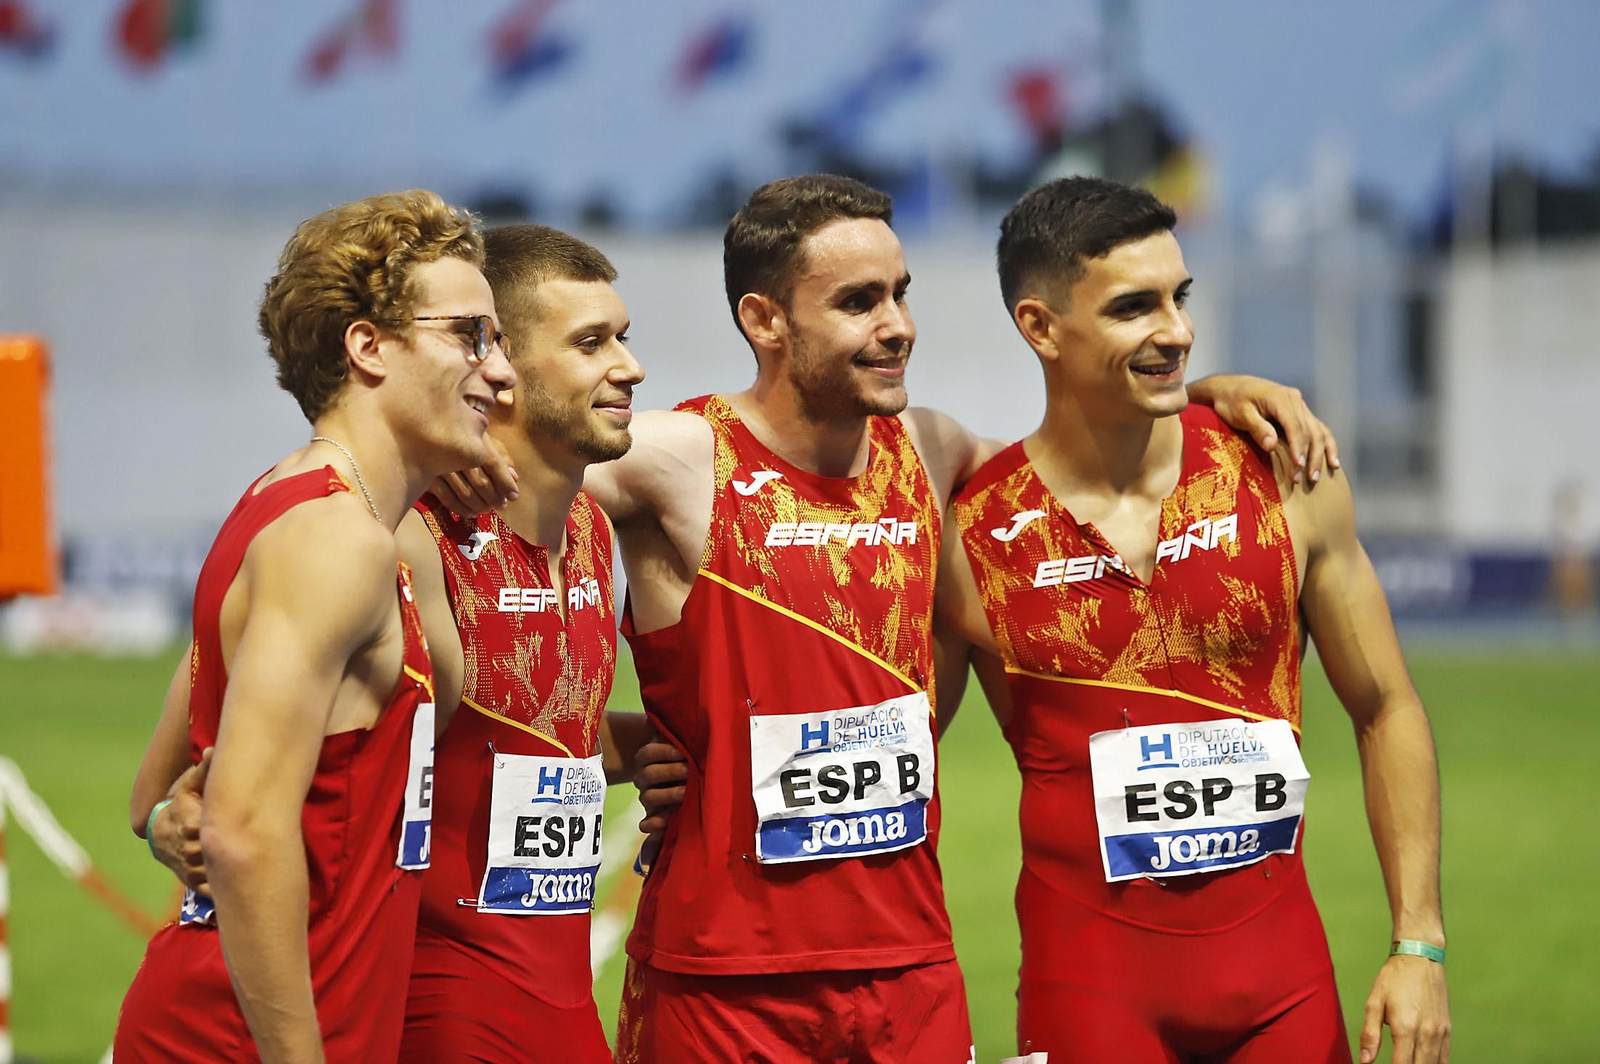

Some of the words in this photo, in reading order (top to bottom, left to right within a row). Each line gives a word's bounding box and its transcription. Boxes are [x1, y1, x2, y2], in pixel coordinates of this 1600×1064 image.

[764, 517, 917, 546] ESPAÑA
[801, 720, 830, 750] H
[834, 730, 850, 744] DE
[858, 721, 907, 740] HUELVA
[1139, 733, 1174, 762] H
[1179, 745, 1200, 758] DE
[1181, 755, 1238, 768] OBJETIVOS
[537, 766, 564, 795] H
[565, 782, 578, 795] DE
[780, 760, 881, 808] ESP
[896, 753, 921, 795] B
[1124, 777, 1233, 823] ESP
[1255, 773, 1287, 812] B
[513, 815, 586, 858] ESP
